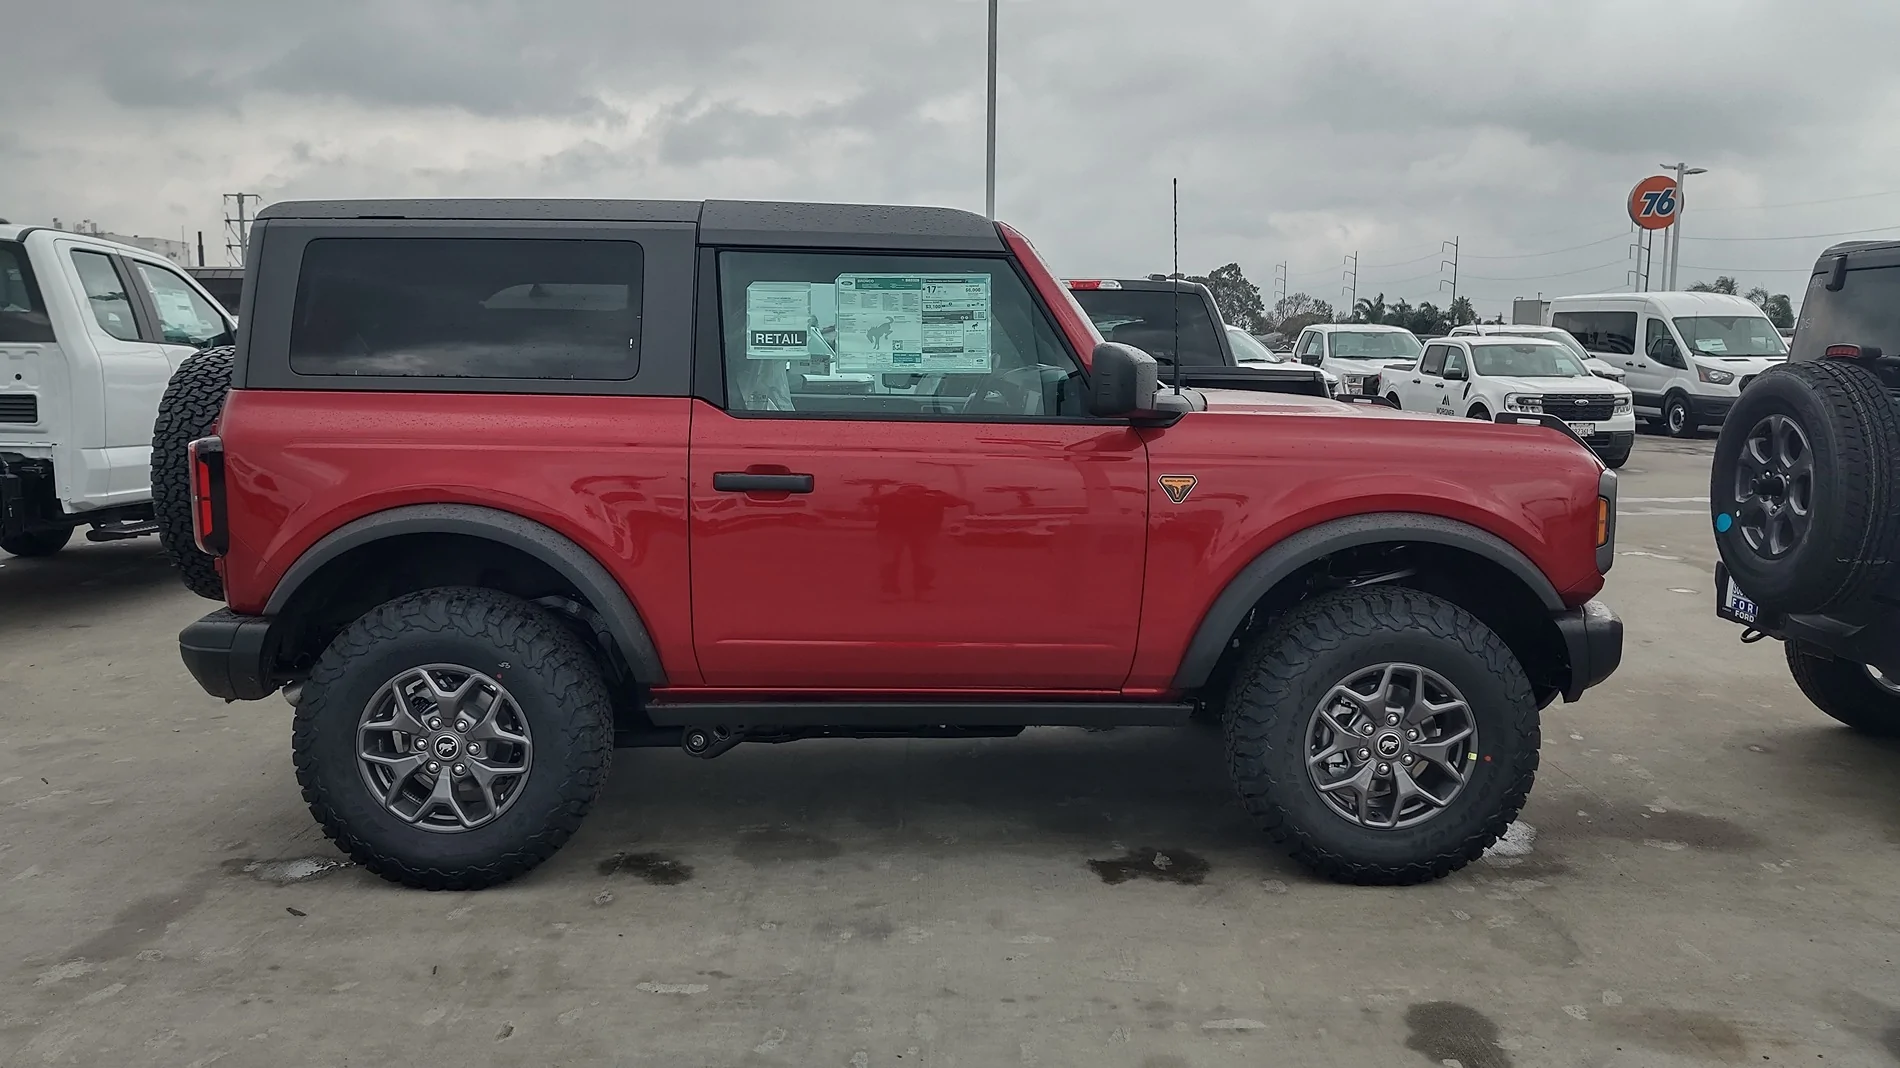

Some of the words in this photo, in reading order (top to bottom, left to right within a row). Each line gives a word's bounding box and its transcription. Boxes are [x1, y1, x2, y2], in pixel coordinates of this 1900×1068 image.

[1640, 187, 1677, 217] 76
[926, 285, 937, 294] 17
[755, 333, 803, 345] RETAIL
[1732, 597, 1758, 617] FOR
[1734, 609, 1755, 623] FORD
